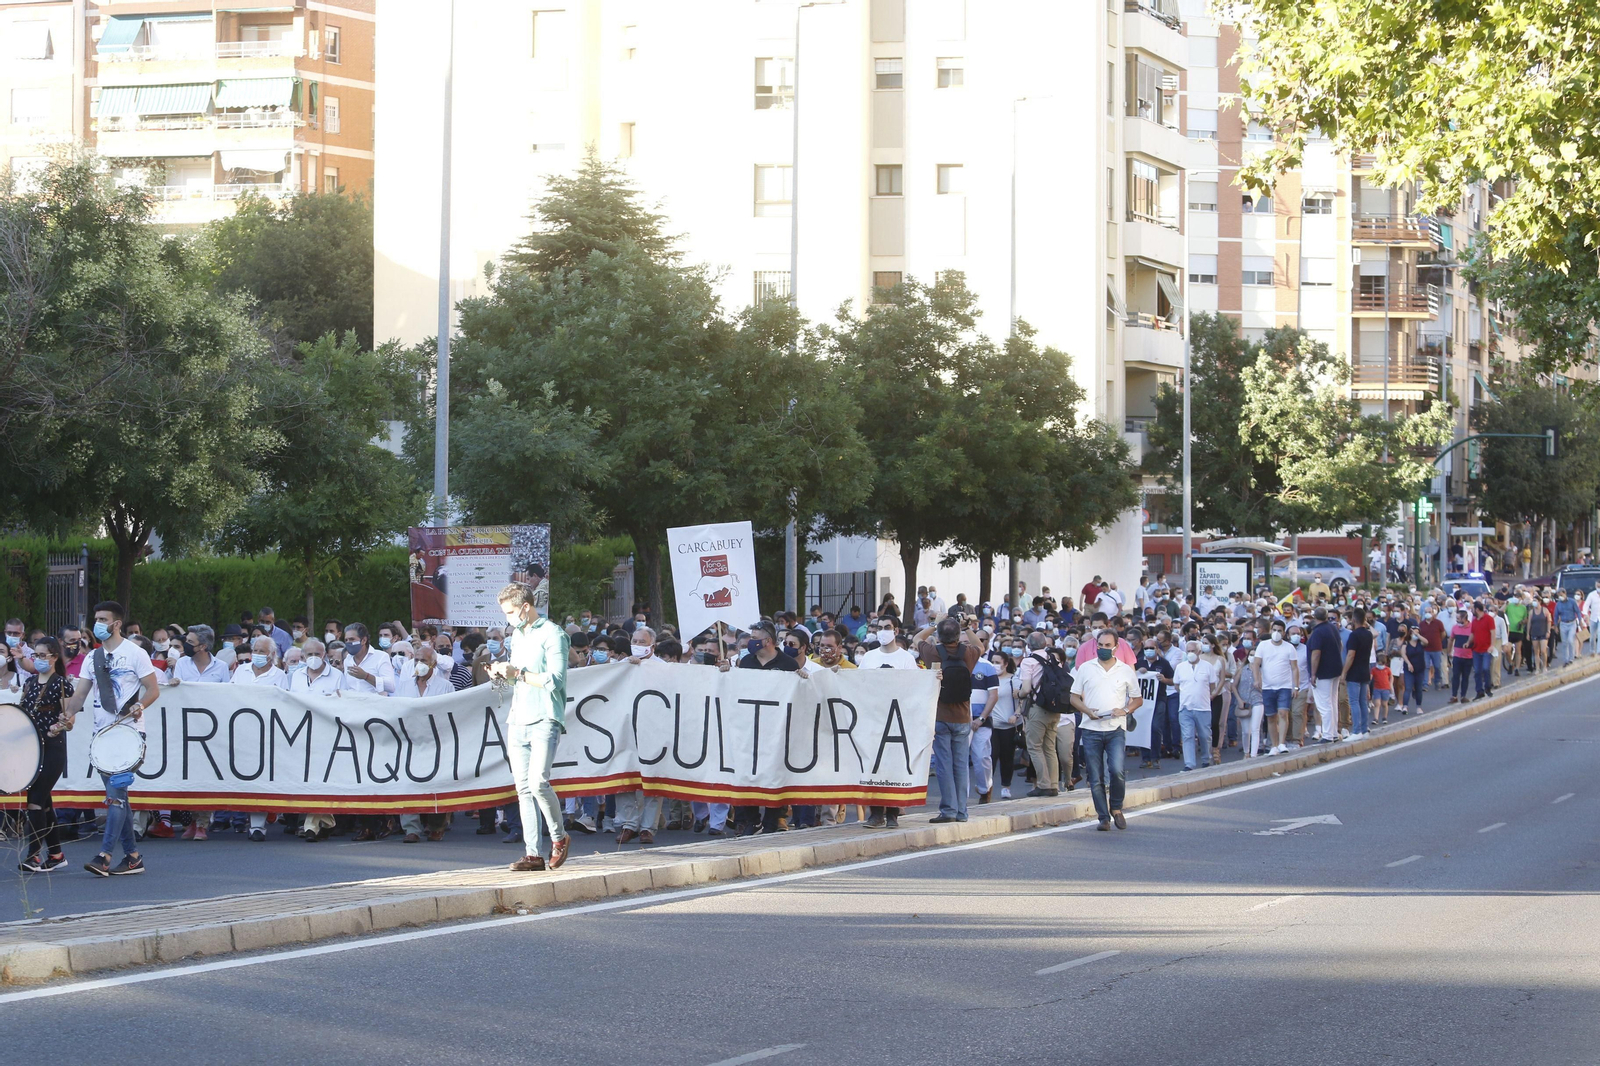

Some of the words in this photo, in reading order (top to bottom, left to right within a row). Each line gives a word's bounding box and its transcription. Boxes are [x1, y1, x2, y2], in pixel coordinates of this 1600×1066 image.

[458, 548, 495, 556] CULTURA
[678, 538, 743, 554] CARCABUEY
[474, 619, 497, 627] FIESTA
[632, 689, 913, 775] CULTURA
